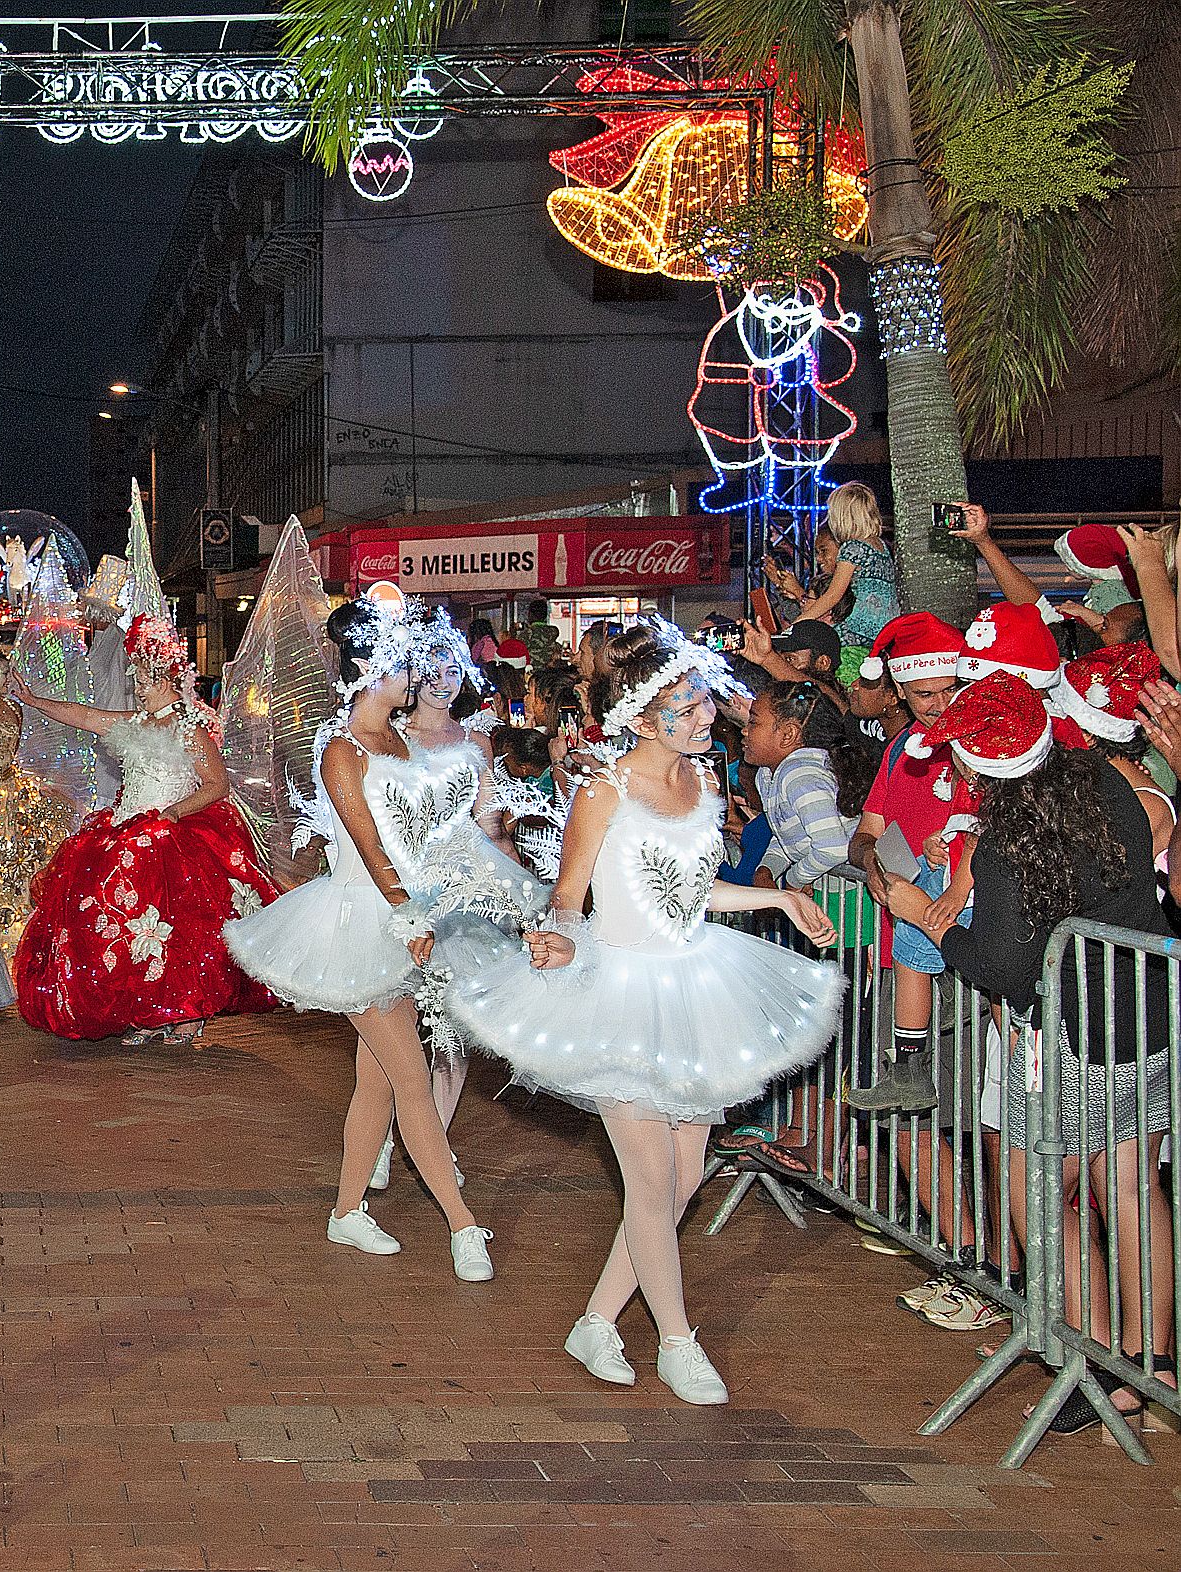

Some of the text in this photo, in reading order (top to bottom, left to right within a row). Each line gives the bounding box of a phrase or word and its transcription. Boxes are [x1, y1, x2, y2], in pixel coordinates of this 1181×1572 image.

[402, 551, 535, 576] 3 MEILLEURS
[586, 539, 695, 575] Coca-Cola
[903, 661, 911, 671] Le
[914, 658, 936, 669] Père
